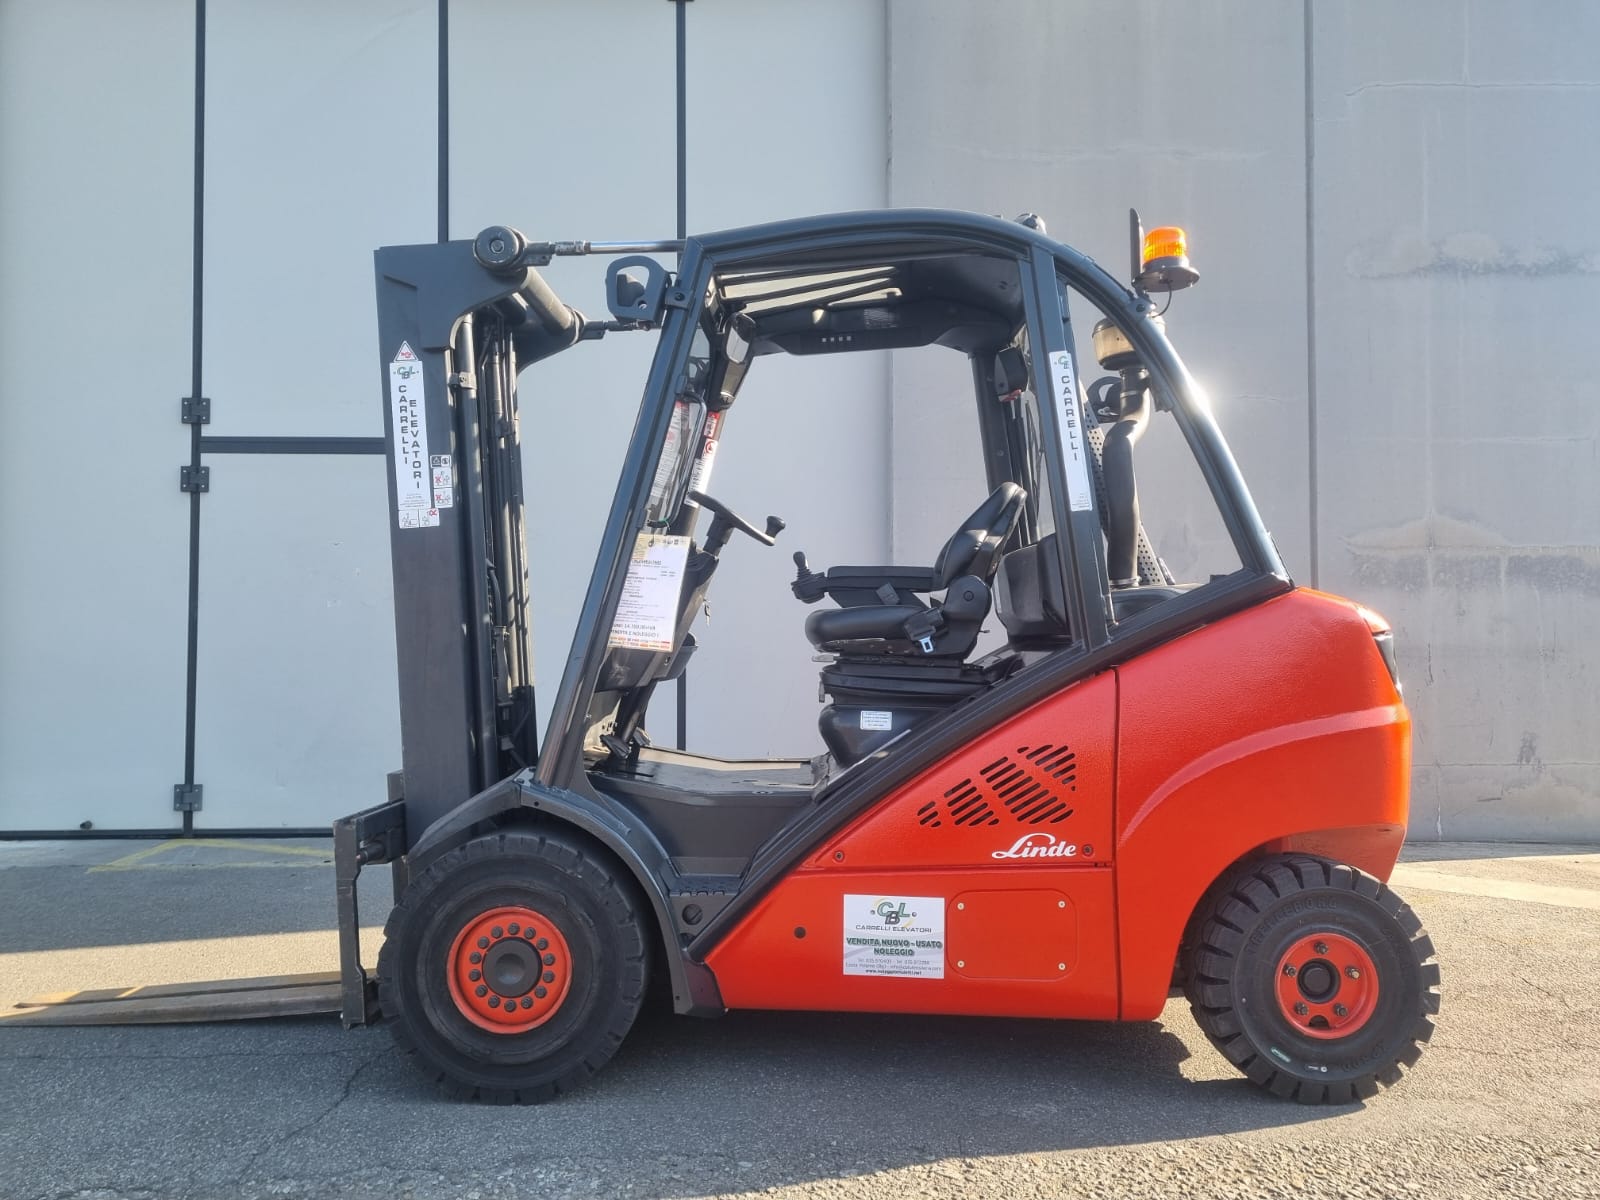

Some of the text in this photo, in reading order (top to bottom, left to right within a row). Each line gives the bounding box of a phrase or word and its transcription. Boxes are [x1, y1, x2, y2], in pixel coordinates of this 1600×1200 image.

[398, 385, 409, 464] CARRELLI
[1061, 375, 1078, 461] CARRELLI
[409, 399, 422, 488] ELEVATORI
[991, 832, 1077, 859] Linde
[855, 924, 891, 932] CARRELLI
[846, 937, 881, 947] VENDITA
[881, 939, 910, 948] NUOVO
[915, 940, 943, 949] USATO
[873, 947, 915, 957] NOLEGGIO
